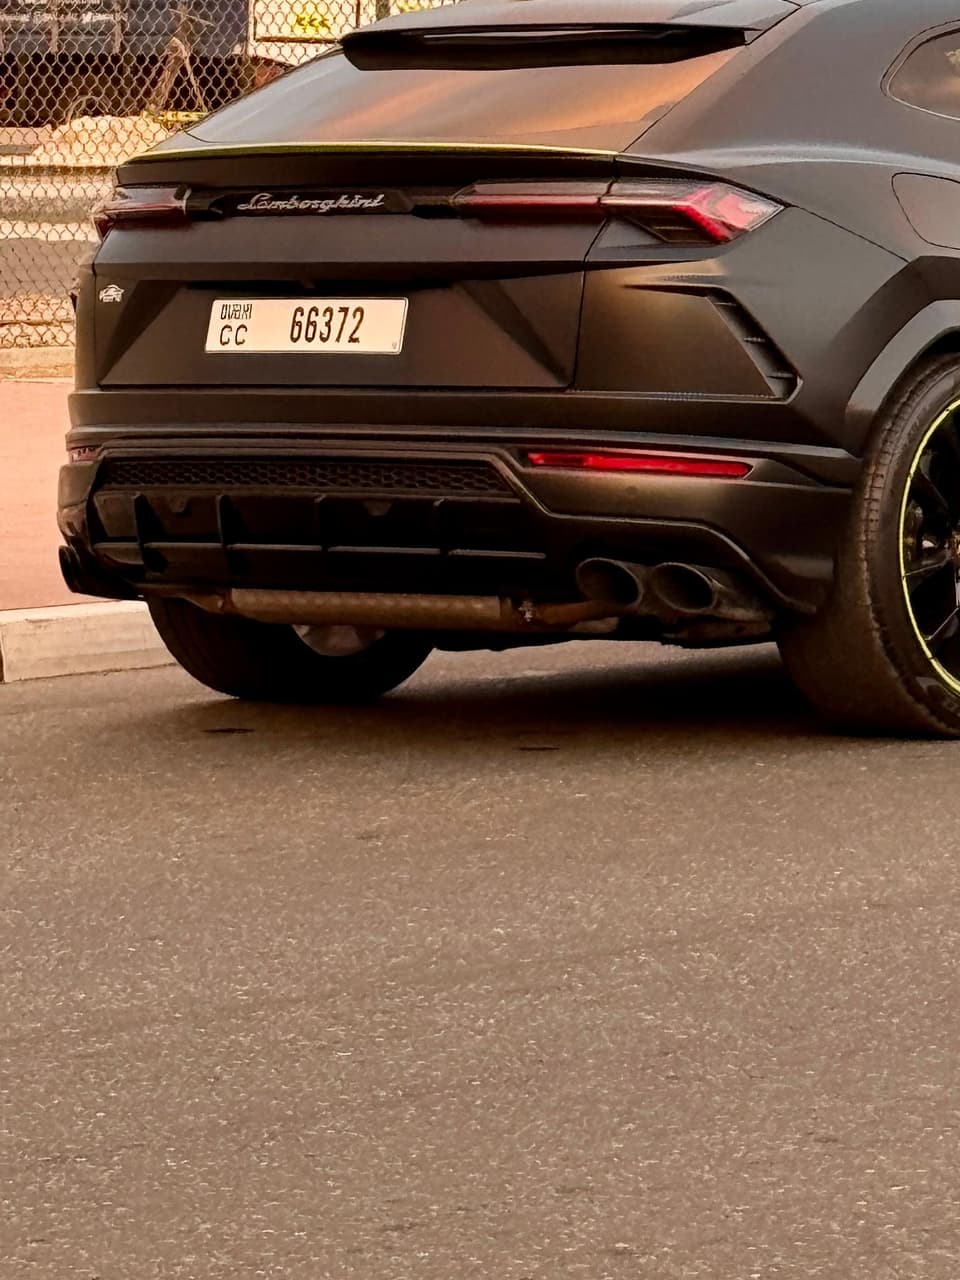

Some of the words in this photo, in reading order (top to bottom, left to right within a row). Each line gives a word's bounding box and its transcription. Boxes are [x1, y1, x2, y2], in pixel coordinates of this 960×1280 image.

[237, 192, 385, 212] Lamborghini
[220, 324, 248, 346] CC
[289, 306, 365, 344] 66372
